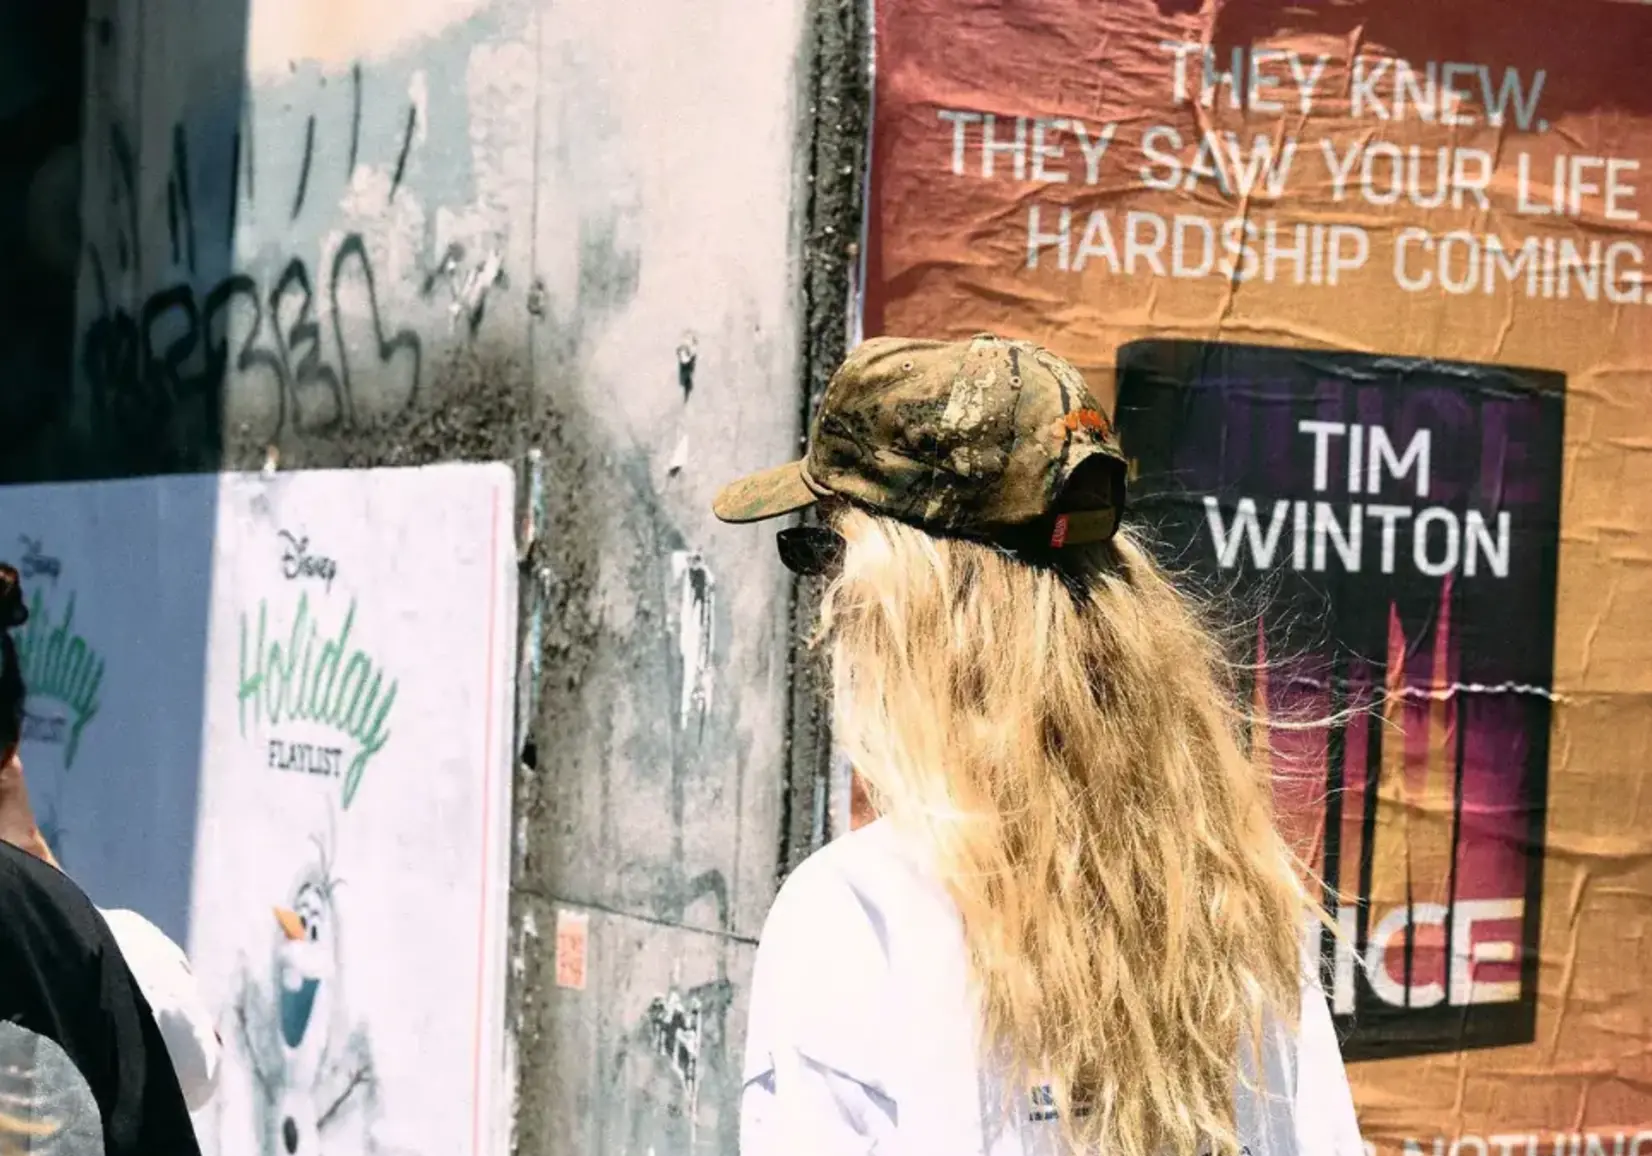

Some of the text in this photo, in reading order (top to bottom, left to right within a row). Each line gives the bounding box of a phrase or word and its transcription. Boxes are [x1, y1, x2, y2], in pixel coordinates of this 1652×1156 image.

[1157, 39, 1549, 133] THEY KNEW.
[936, 109, 1640, 222] THEY SAW YOUR LIFE
[1025, 205, 1652, 305] HARDSHIP COMING.
[1299, 420, 1431, 498] TIM
[277, 529, 338, 594] Disney
[1202, 495, 1511, 578] WINTON
[237, 591, 398, 812] Holiday
[268, 741, 343, 778] PLAYLIST
[1301, 898, 1526, 1016] ICE
